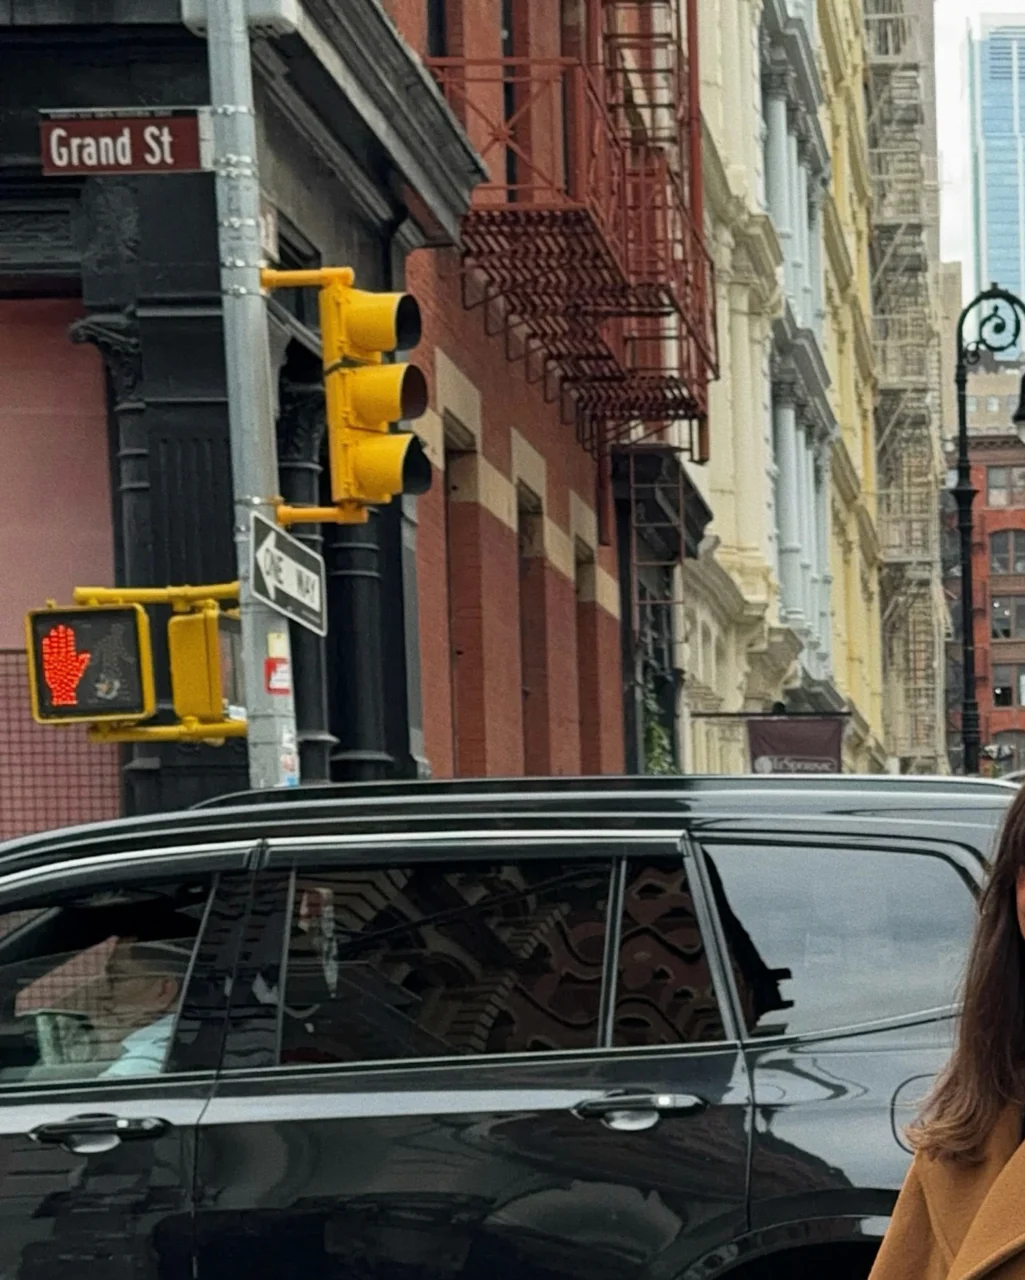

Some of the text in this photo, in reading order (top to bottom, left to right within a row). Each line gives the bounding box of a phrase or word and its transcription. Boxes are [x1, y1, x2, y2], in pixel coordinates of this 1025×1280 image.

[50, 125, 175, 167] Grand St
[263, 547, 317, 604] ONE WAY
